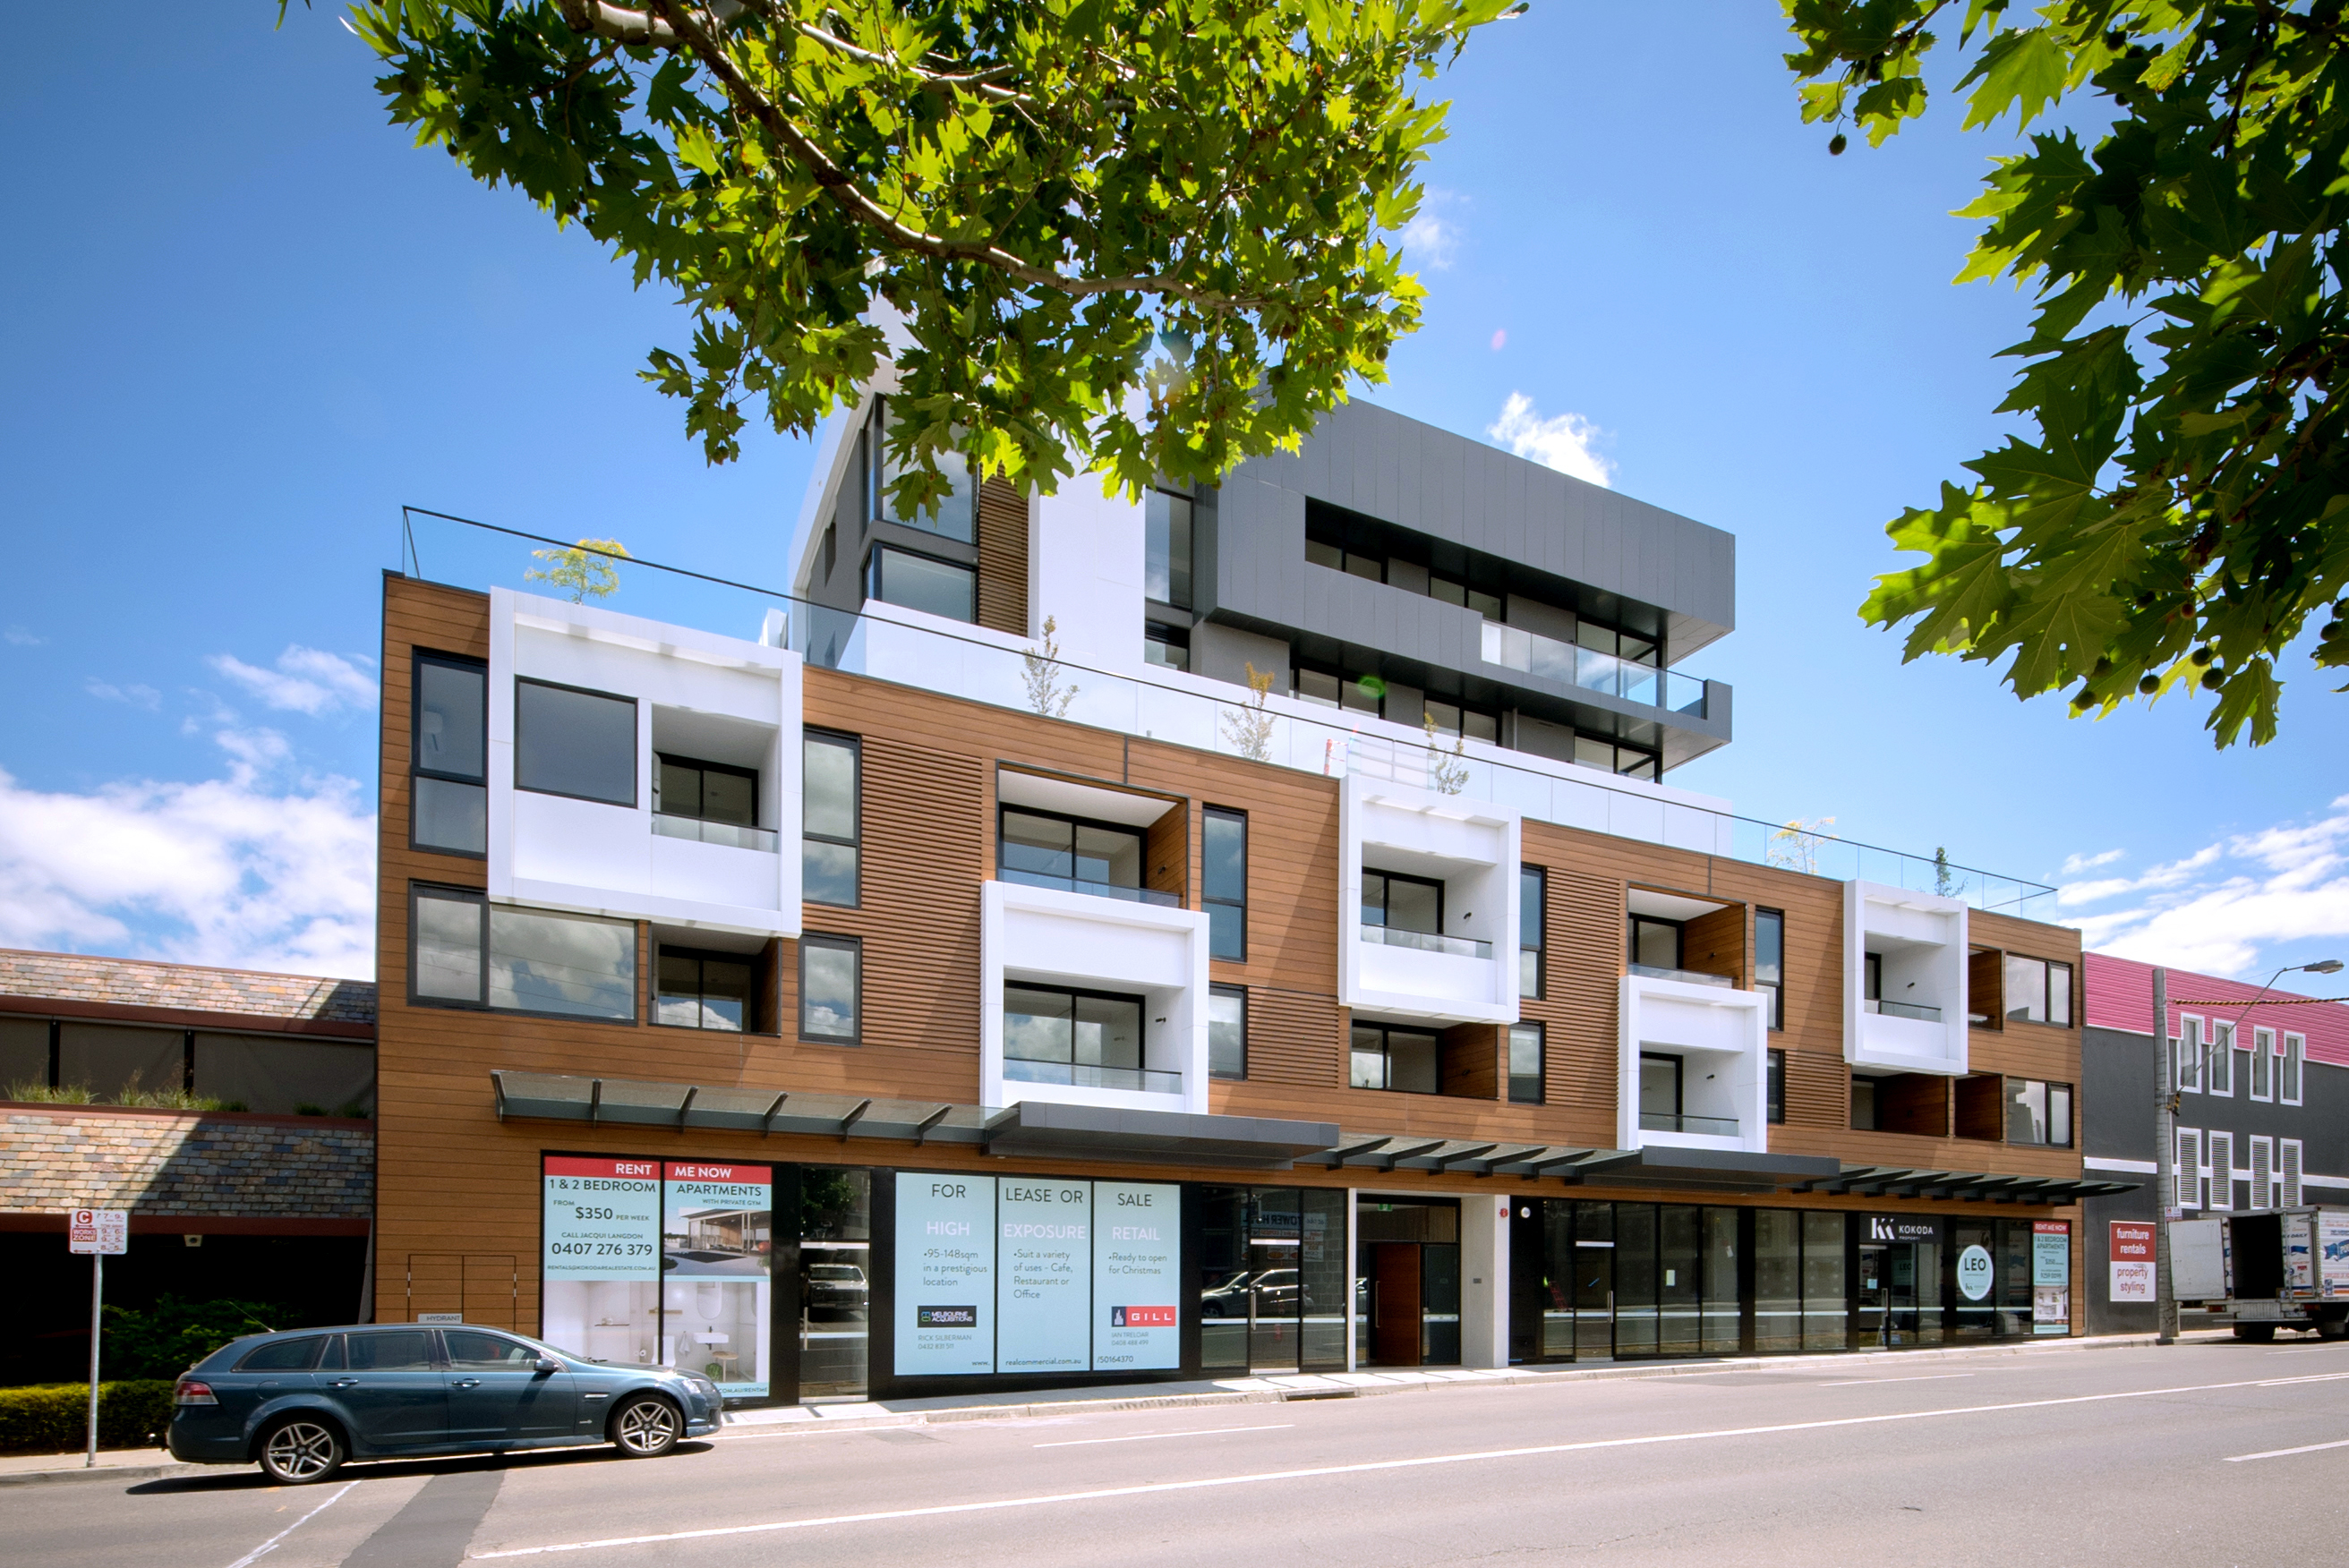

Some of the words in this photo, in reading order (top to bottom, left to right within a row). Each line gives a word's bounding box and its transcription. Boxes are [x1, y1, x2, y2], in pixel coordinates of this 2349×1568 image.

[616, 1163, 652, 1175] RENT
[674, 1166, 696, 1178] ME
[698, 1167, 731, 1179] NOW
[550, 1180, 555, 1189] 1
[559, 1180, 569, 1190] &
[571, 1180, 579, 1190] 2
[584, 1180, 656, 1193] BEDROOM
[677, 1184, 761, 1197] APARTMENTS
[931, 1184, 966, 1198] FOR
[1005, 1189, 1052, 1203] LEASE
[1060, 1189, 1083, 1204] OR
[1117, 1194, 1152, 1206] SALE
[575, 1206, 613, 1221] $350
[927, 1221, 970, 1237] HIGH
[1004, 1223, 1086, 1240] EXPOSURE
[1112, 1226, 1161, 1240] RETAIL
[1899, 1224, 1934, 1235] KOKODA
[2116, 1228, 2149, 1240] furniture
[551, 1242, 593, 1255] 0407
[596, 1243, 622, 1256] 276
[627, 1244, 653, 1256] 379
[2120, 1243, 2147, 1255] rentals
[1042, 1250, 1071, 1262] variety
[1138, 1254, 1147, 1262] to
[1149, 1255, 1167, 1264] open
[923, 1264, 932, 1273] in
[941, 1264, 987, 1275] prestigious
[1013, 1263, 1023, 1272] of
[1108, 1265, 1120, 1274] for
[1122, 1265, 1161, 1274] Christmas
[1964, 1257, 1986, 1271] LEO
[2117, 1267, 2148, 1280] property
[923, 1277, 958, 1286] location
[1013, 1276, 1059, 1285] Restaurant
[2120, 1281, 2146, 1294] styling
[1013, 1290, 1040, 1299] Office
[1132, 1312, 1172, 1321] GILL
[1005, 1358, 1081, 1366] realcommercial.com.au
